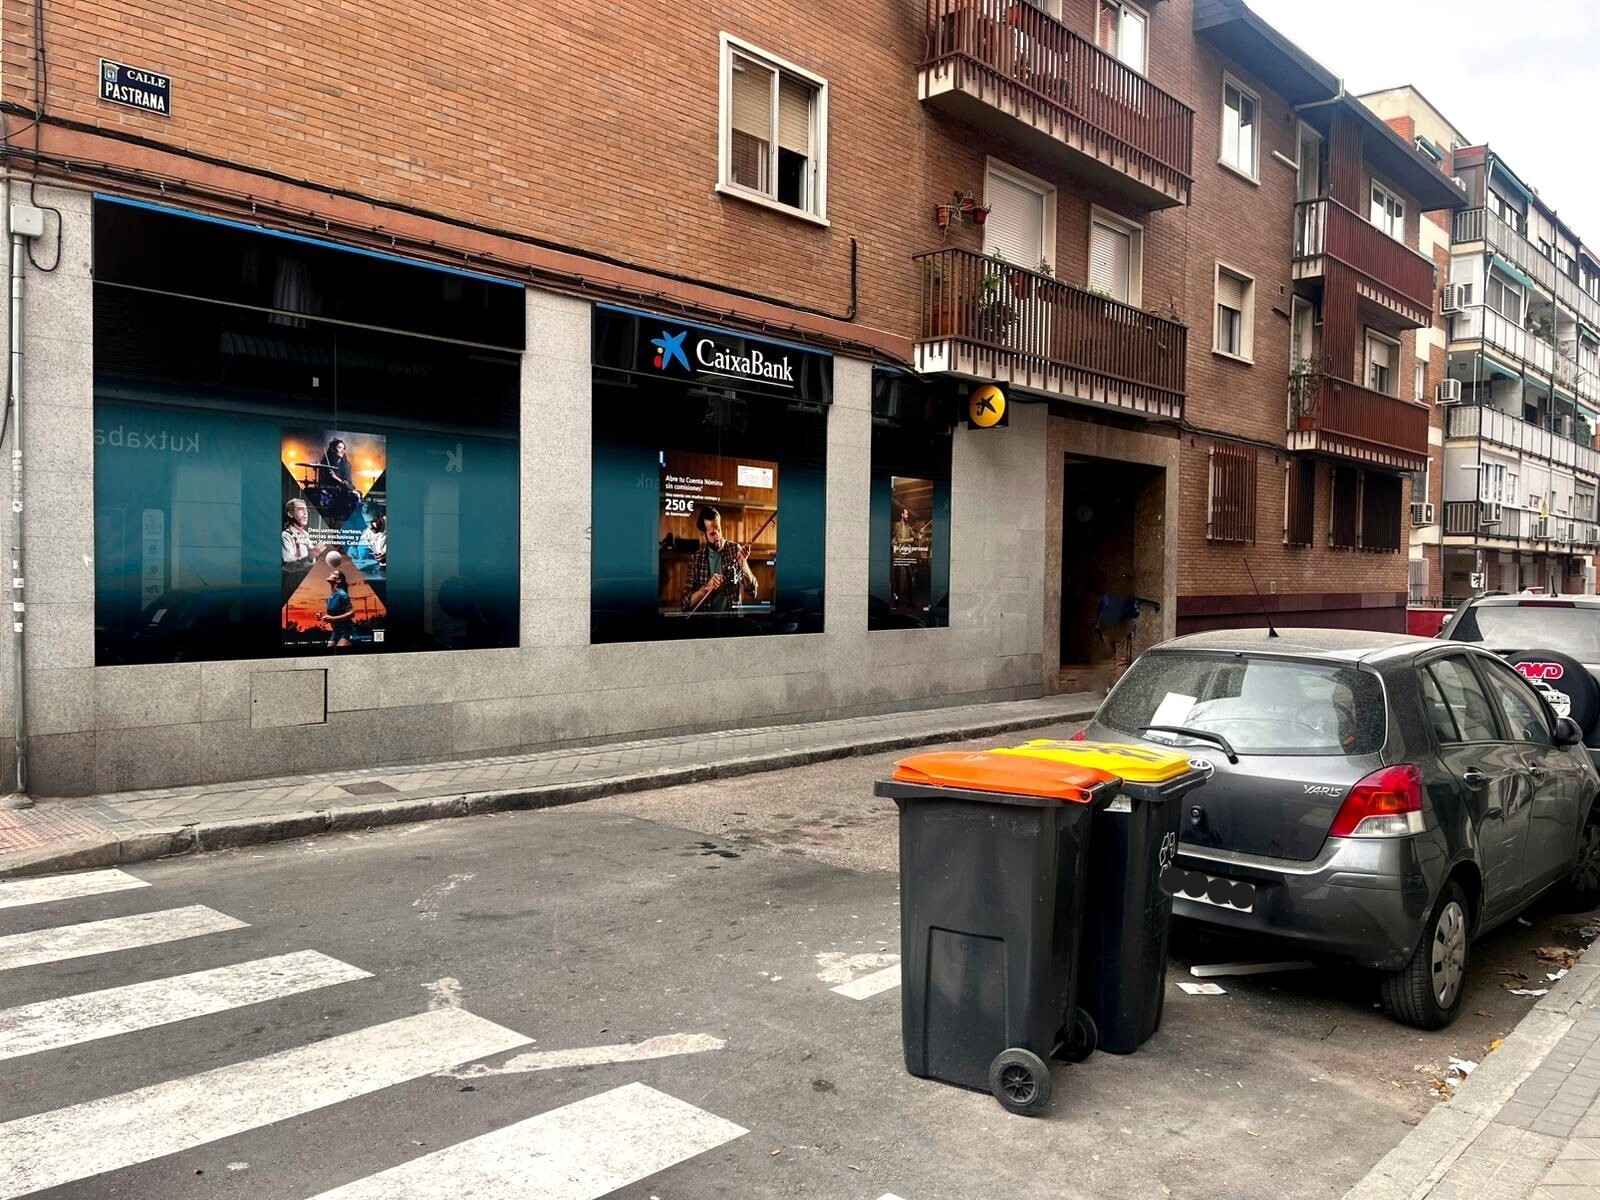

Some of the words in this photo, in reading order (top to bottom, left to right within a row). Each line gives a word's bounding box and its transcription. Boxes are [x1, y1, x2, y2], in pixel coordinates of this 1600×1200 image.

[126, 70, 166, 89] CALLE
[105, 81, 165, 111] PASTRANA
[696, 339, 794, 381] CaixaBank
[665, 498, 686, 511] 250
[1304, 784, 1343, 797] YARIS
